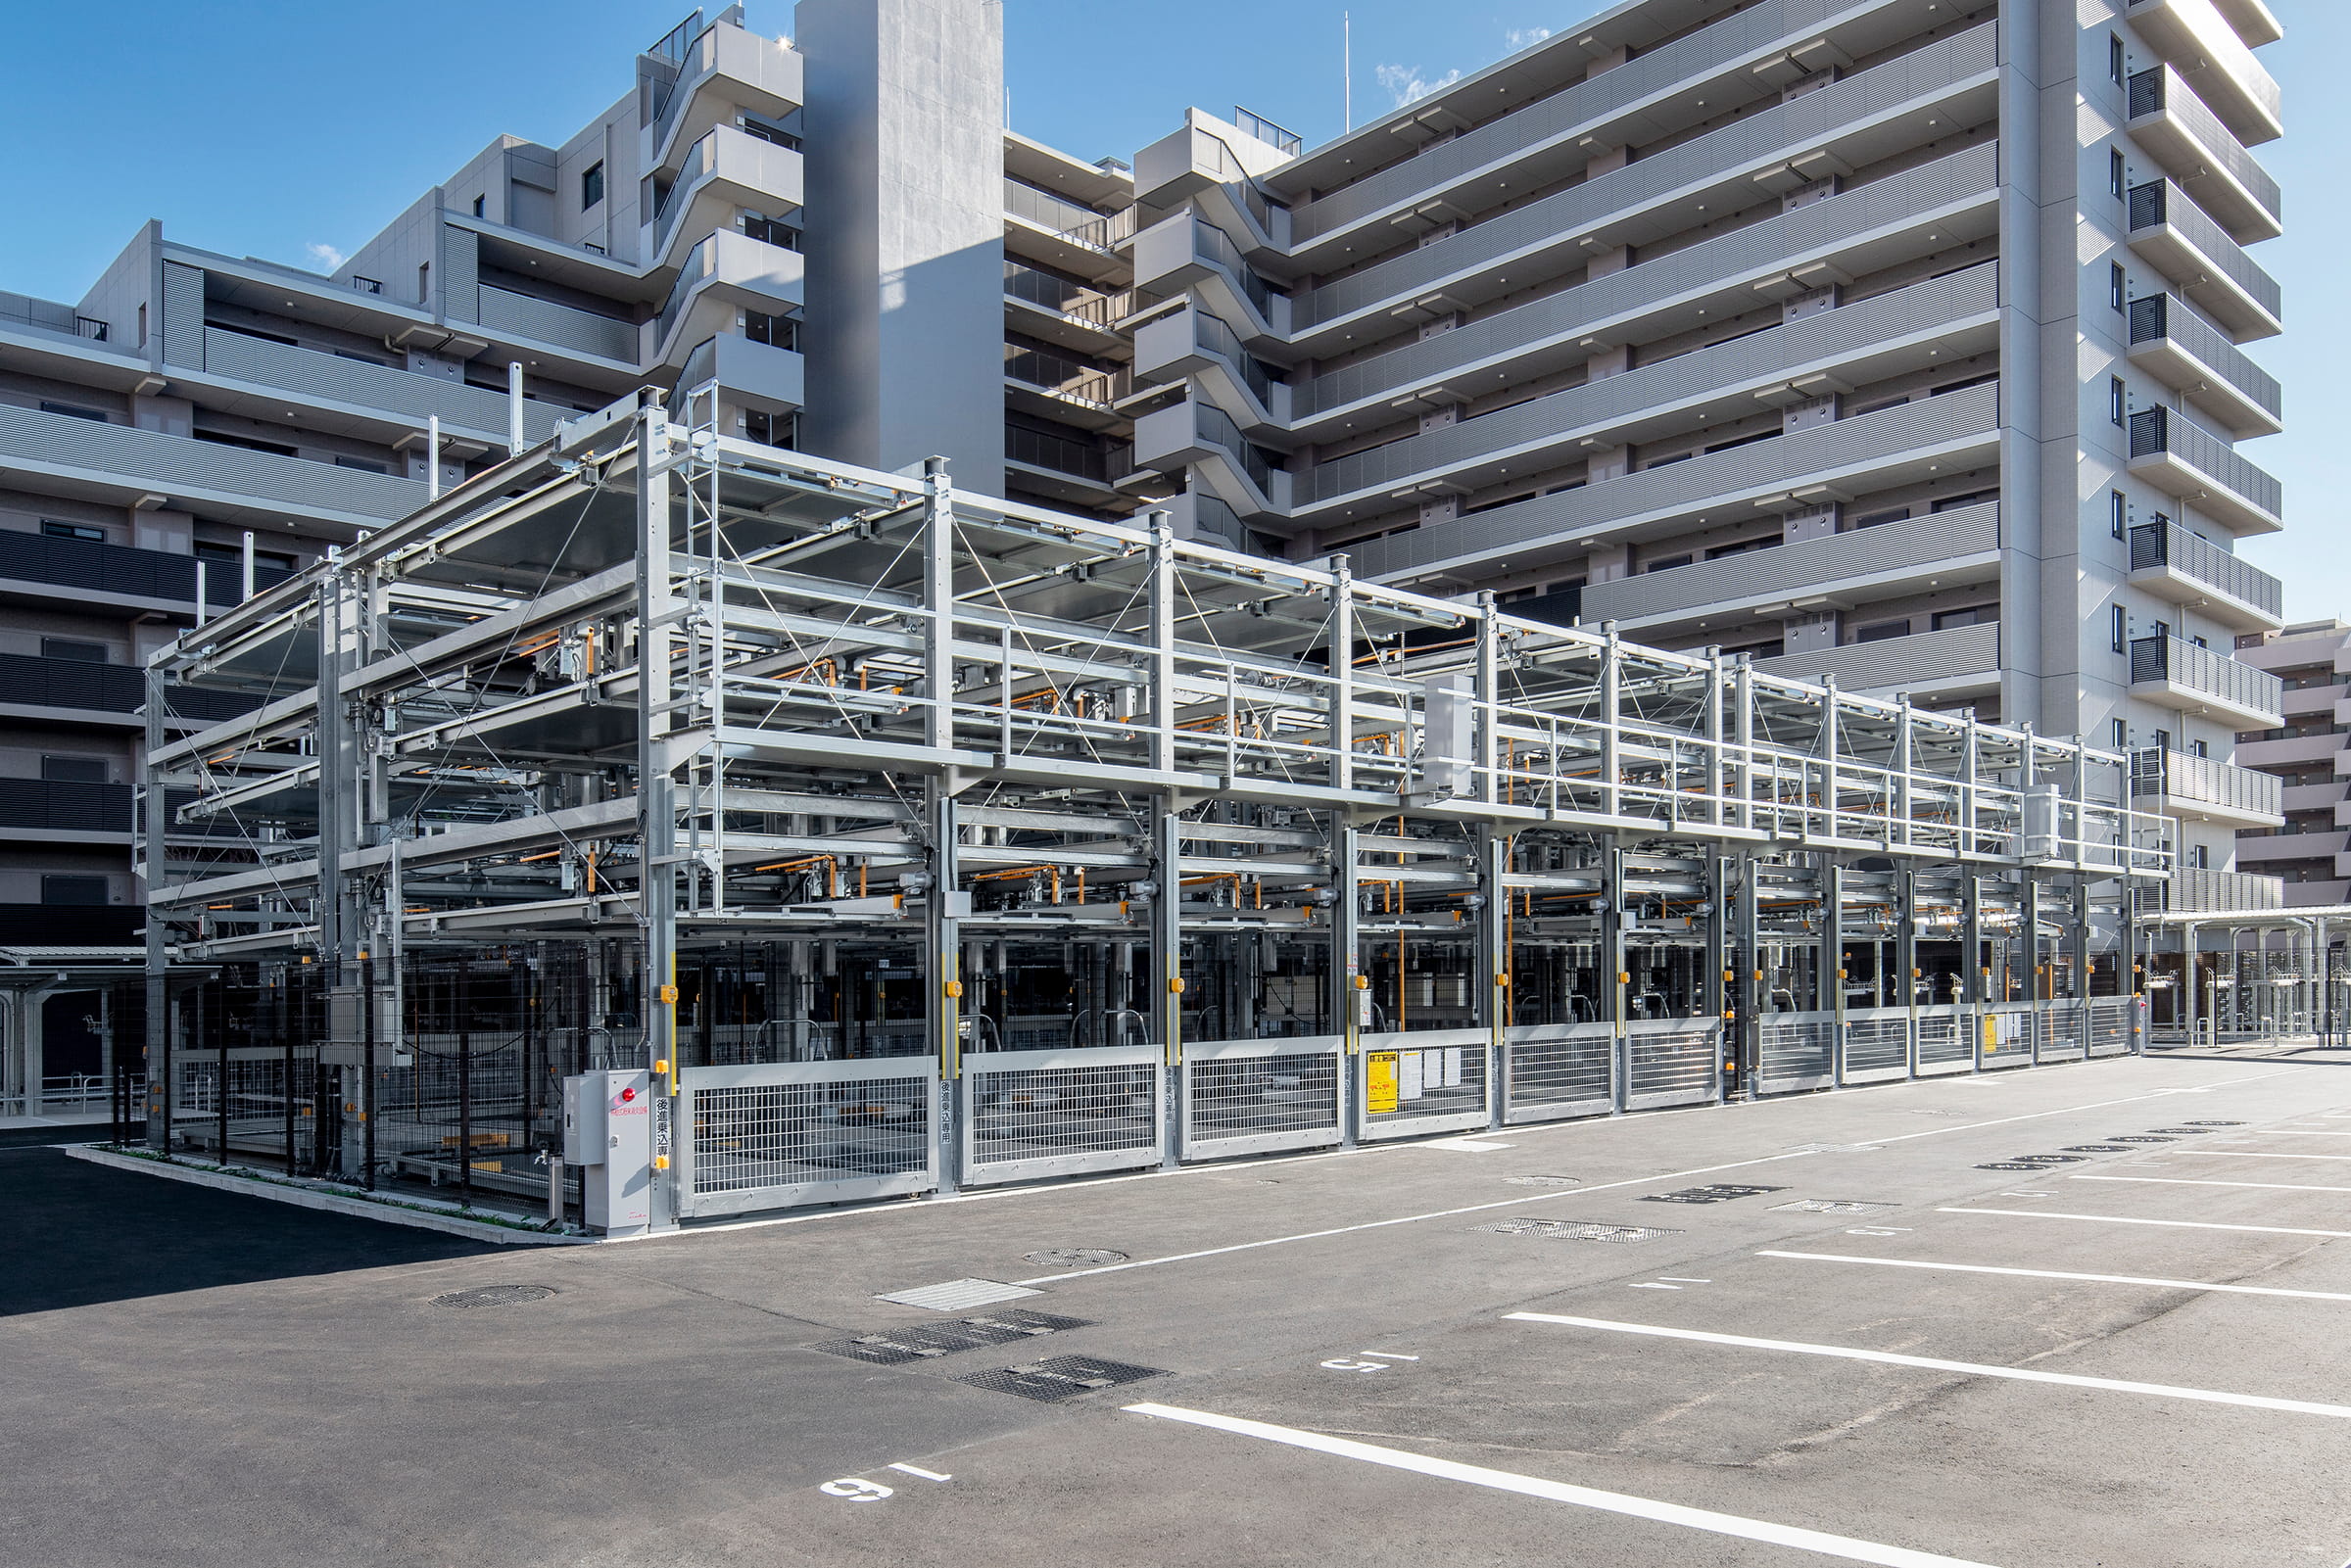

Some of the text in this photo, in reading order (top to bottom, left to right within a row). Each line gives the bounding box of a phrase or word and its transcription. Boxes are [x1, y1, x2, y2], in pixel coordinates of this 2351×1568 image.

[656, 1098, 668, 1157] 後進乗込専
[1845, 1225, 1914, 1236] 13
[1319, 1351, 1420, 1373] 15
[819, 1462, 952, 1502] 16
